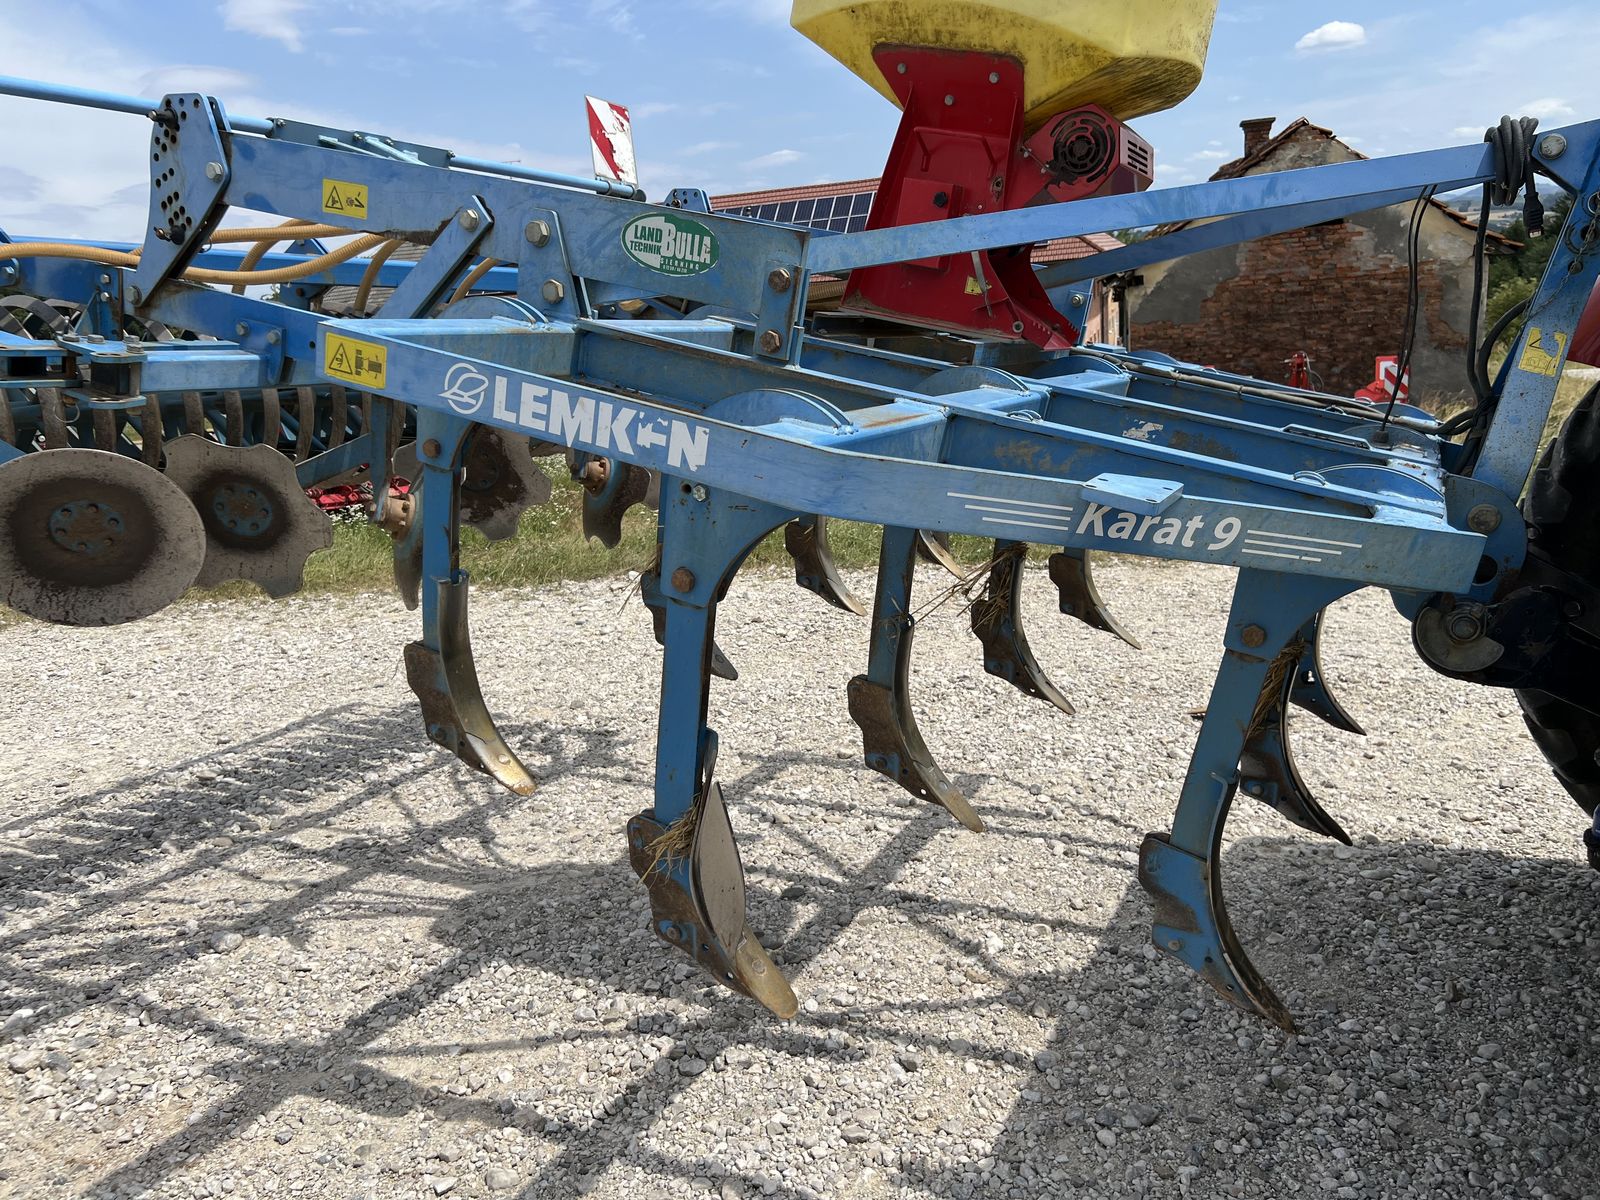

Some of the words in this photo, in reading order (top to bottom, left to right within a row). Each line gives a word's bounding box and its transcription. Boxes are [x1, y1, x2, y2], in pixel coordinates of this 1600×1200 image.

[630, 240, 662, 255] TECHNIK
[633, 225, 663, 244] LAND
[660, 222, 711, 264] BULLA
[1075, 502, 1204, 548] Karat
[1207, 516, 1242, 551] 9
